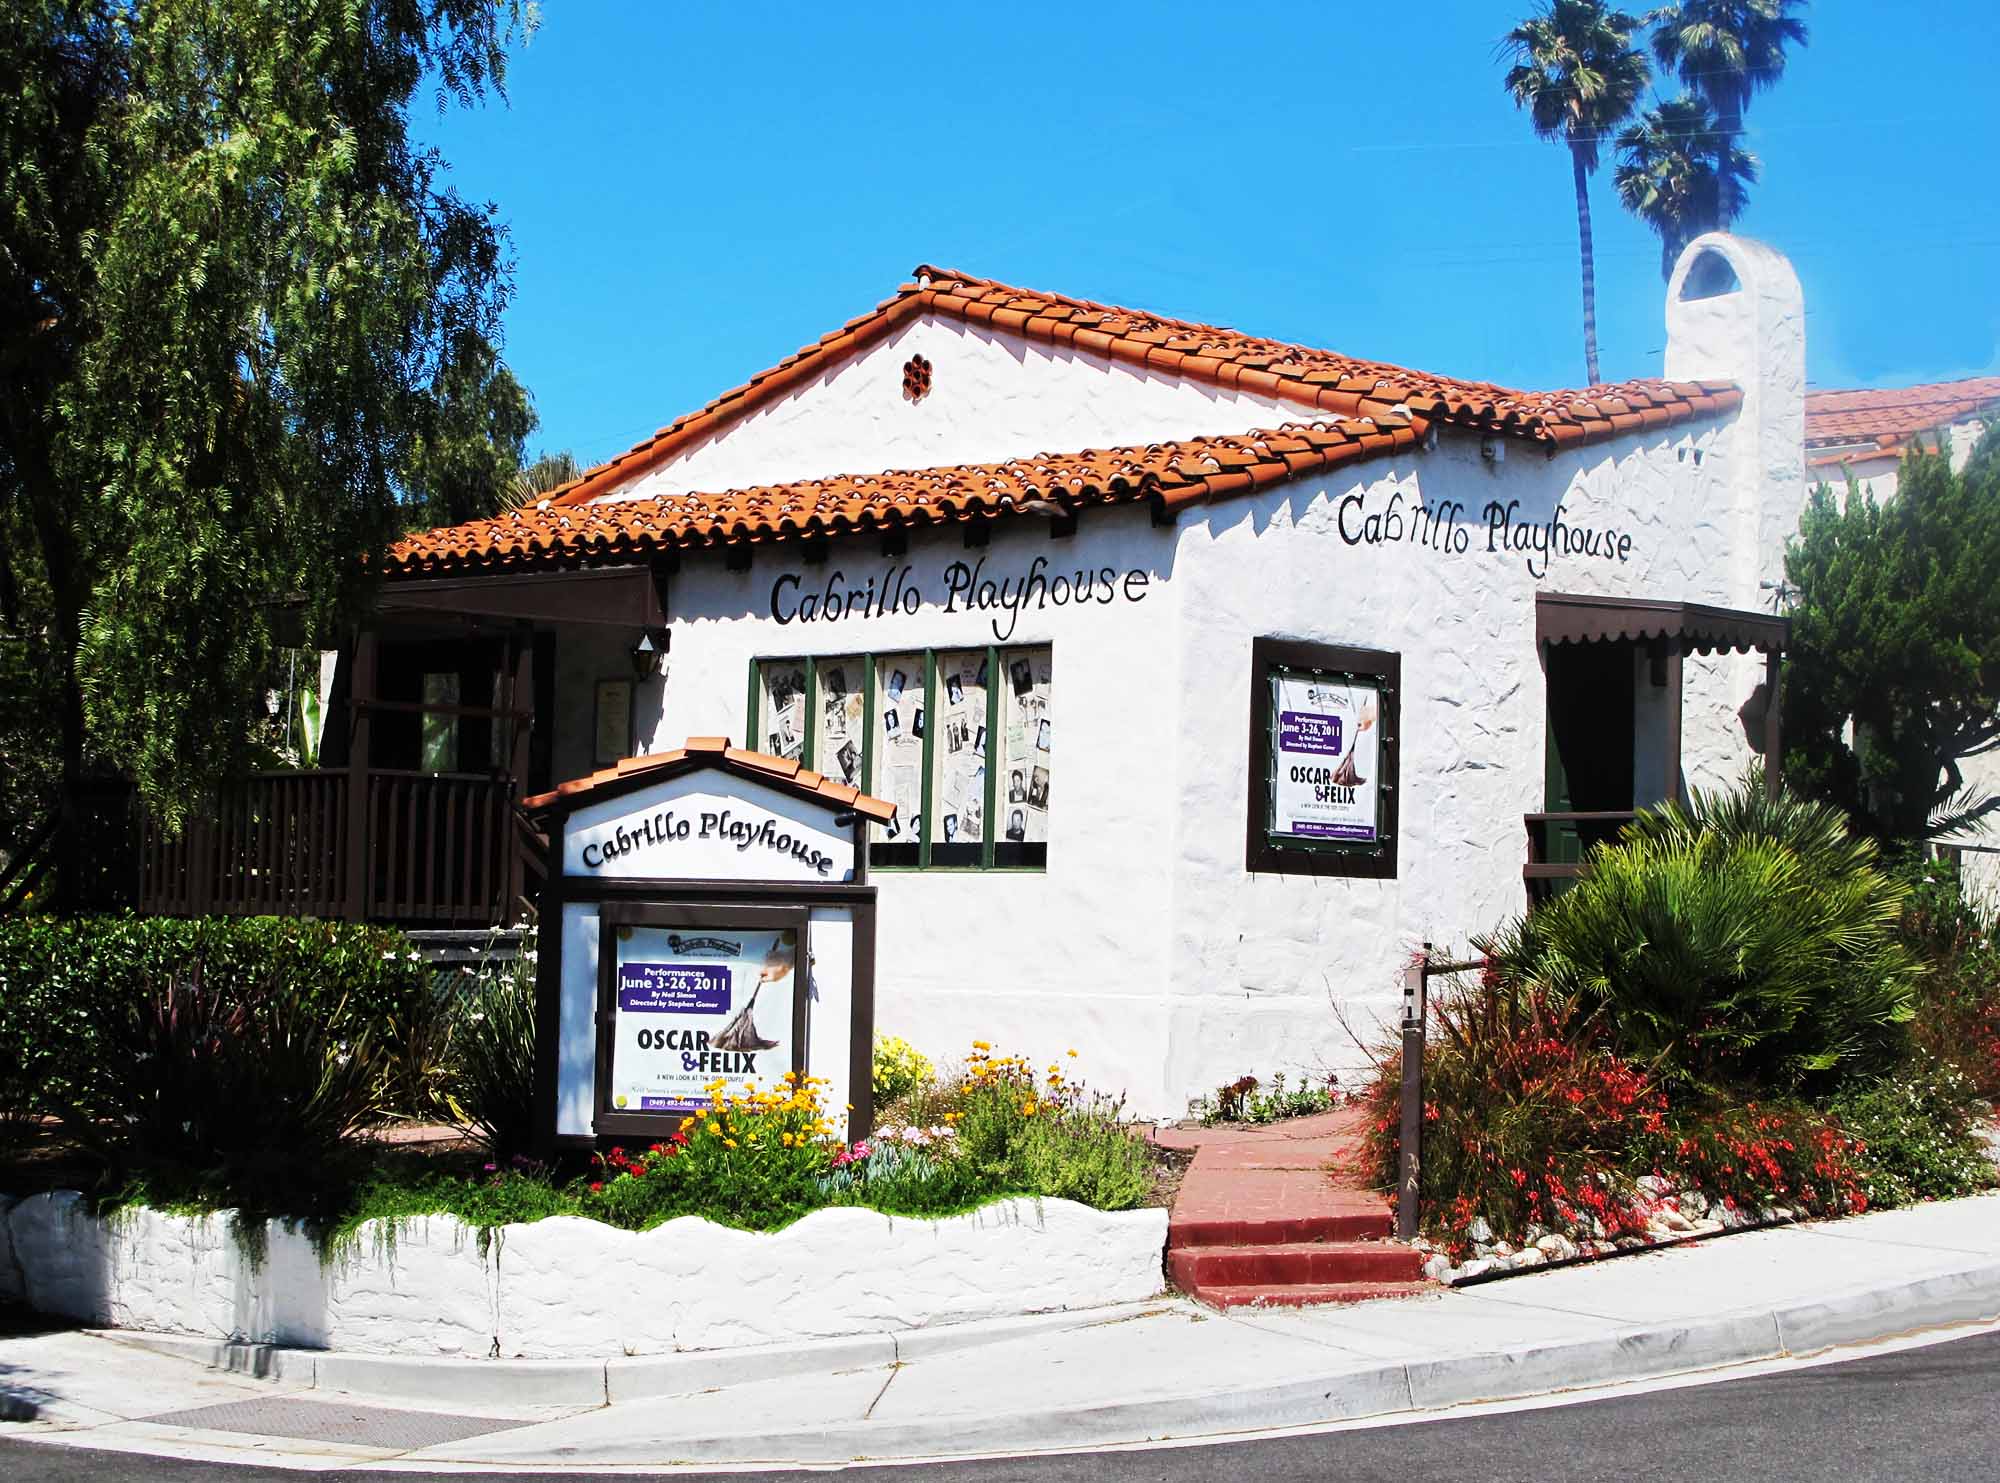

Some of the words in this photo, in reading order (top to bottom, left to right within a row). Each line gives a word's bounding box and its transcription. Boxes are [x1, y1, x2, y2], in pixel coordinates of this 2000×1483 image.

[1338, 493, 1469, 555] Cabrillo
[1483, 499, 1632, 579] Playhouse
[770, 564, 921, 625] Cabrillo
[943, 556, 1151, 641] Playhouse
[1280, 721, 1300, 735] June
[1301, 723, 1321, 737] 3-26,
[1321, 725, 1340, 737] 2011
[1290, 765, 1331, 786] OSCAR
[582, 810, 691, 870] Cabrillo
[698, 810, 834, 877] Playhouse
[644, 967, 705, 978] Performances
[619, 976, 653, 991] June
[656, 977, 691, 992] 3-26,
[694, 978, 726, 991] 2011
[630, 999, 658, 1007] Directed
[658, 1000, 666, 1009] by
[667, 1000, 695, 1009] Stephen
[651, 991, 660, 1000] By
[661, 991, 676, 999] Neil
[676, 991, 697, 999] Simon
[637, 1029, 710, 1051] OSCAR
